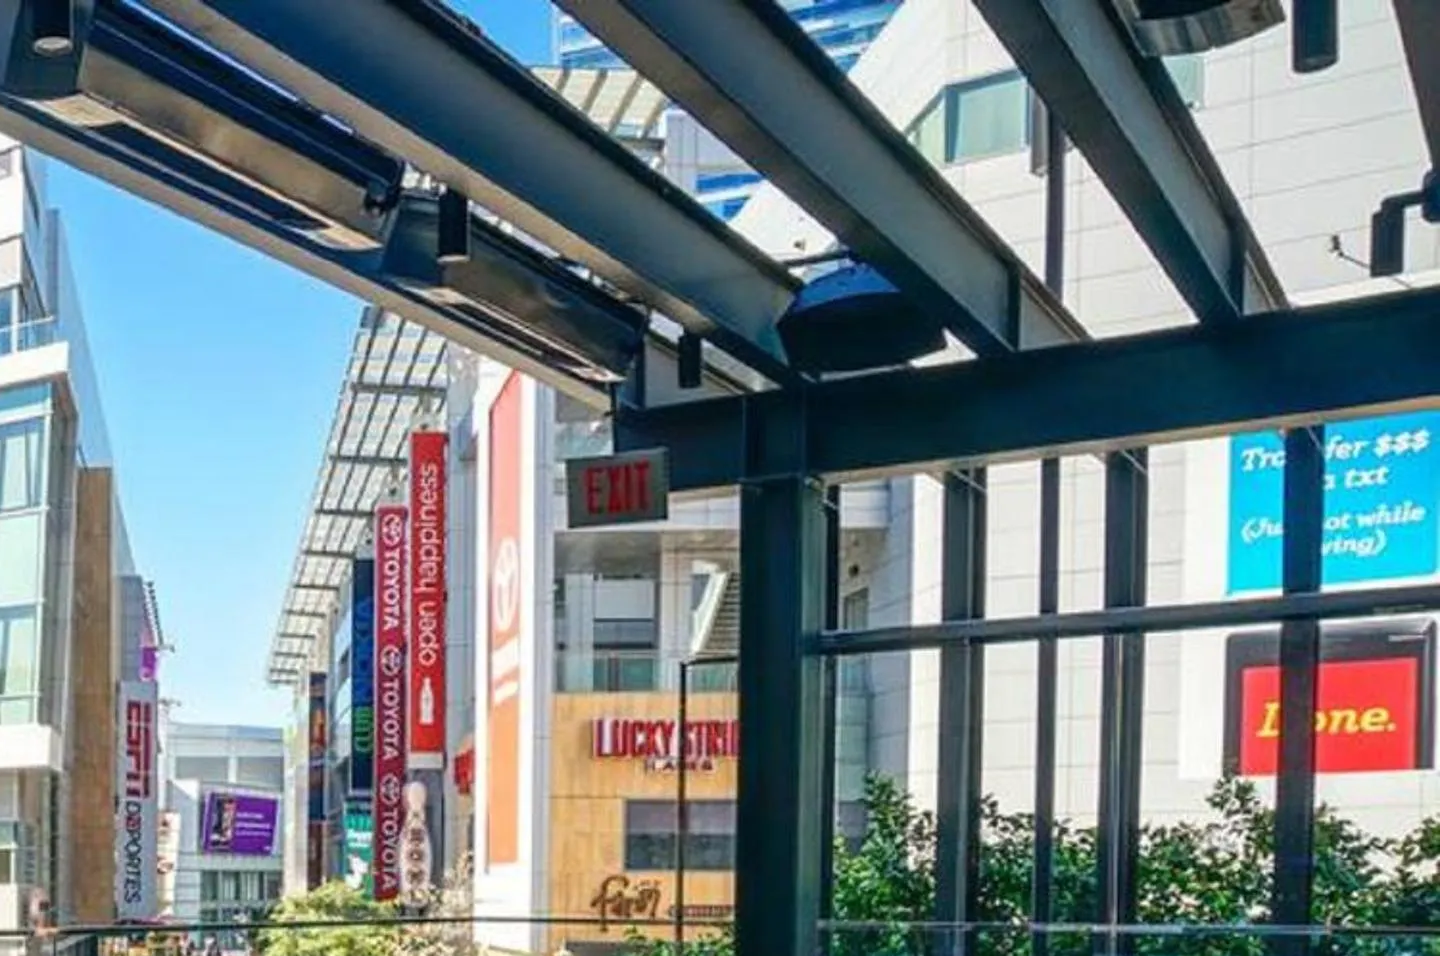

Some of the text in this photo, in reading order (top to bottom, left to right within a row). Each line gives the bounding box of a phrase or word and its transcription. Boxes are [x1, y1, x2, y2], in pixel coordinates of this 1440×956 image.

[1241, 427, 1430, 471] Trafer $$$
[585, 460, 649, 515] EXIT
[1344, 465, 1389, 489] txt
[1240, 500, 1427, 544] (Ju ot while
[1321, 528, 1388, 558] ving)
[383, 549, 400, 630] TOYOTA
[413, 462, 441, 666] open happiness
[382, 678, 400, 760] TOYOTA
[594, 719, 739, 758] LUCKY STRI
[126, 701, 150, 798] ESPN
[382, 807, 399, 892] TOYOTA
